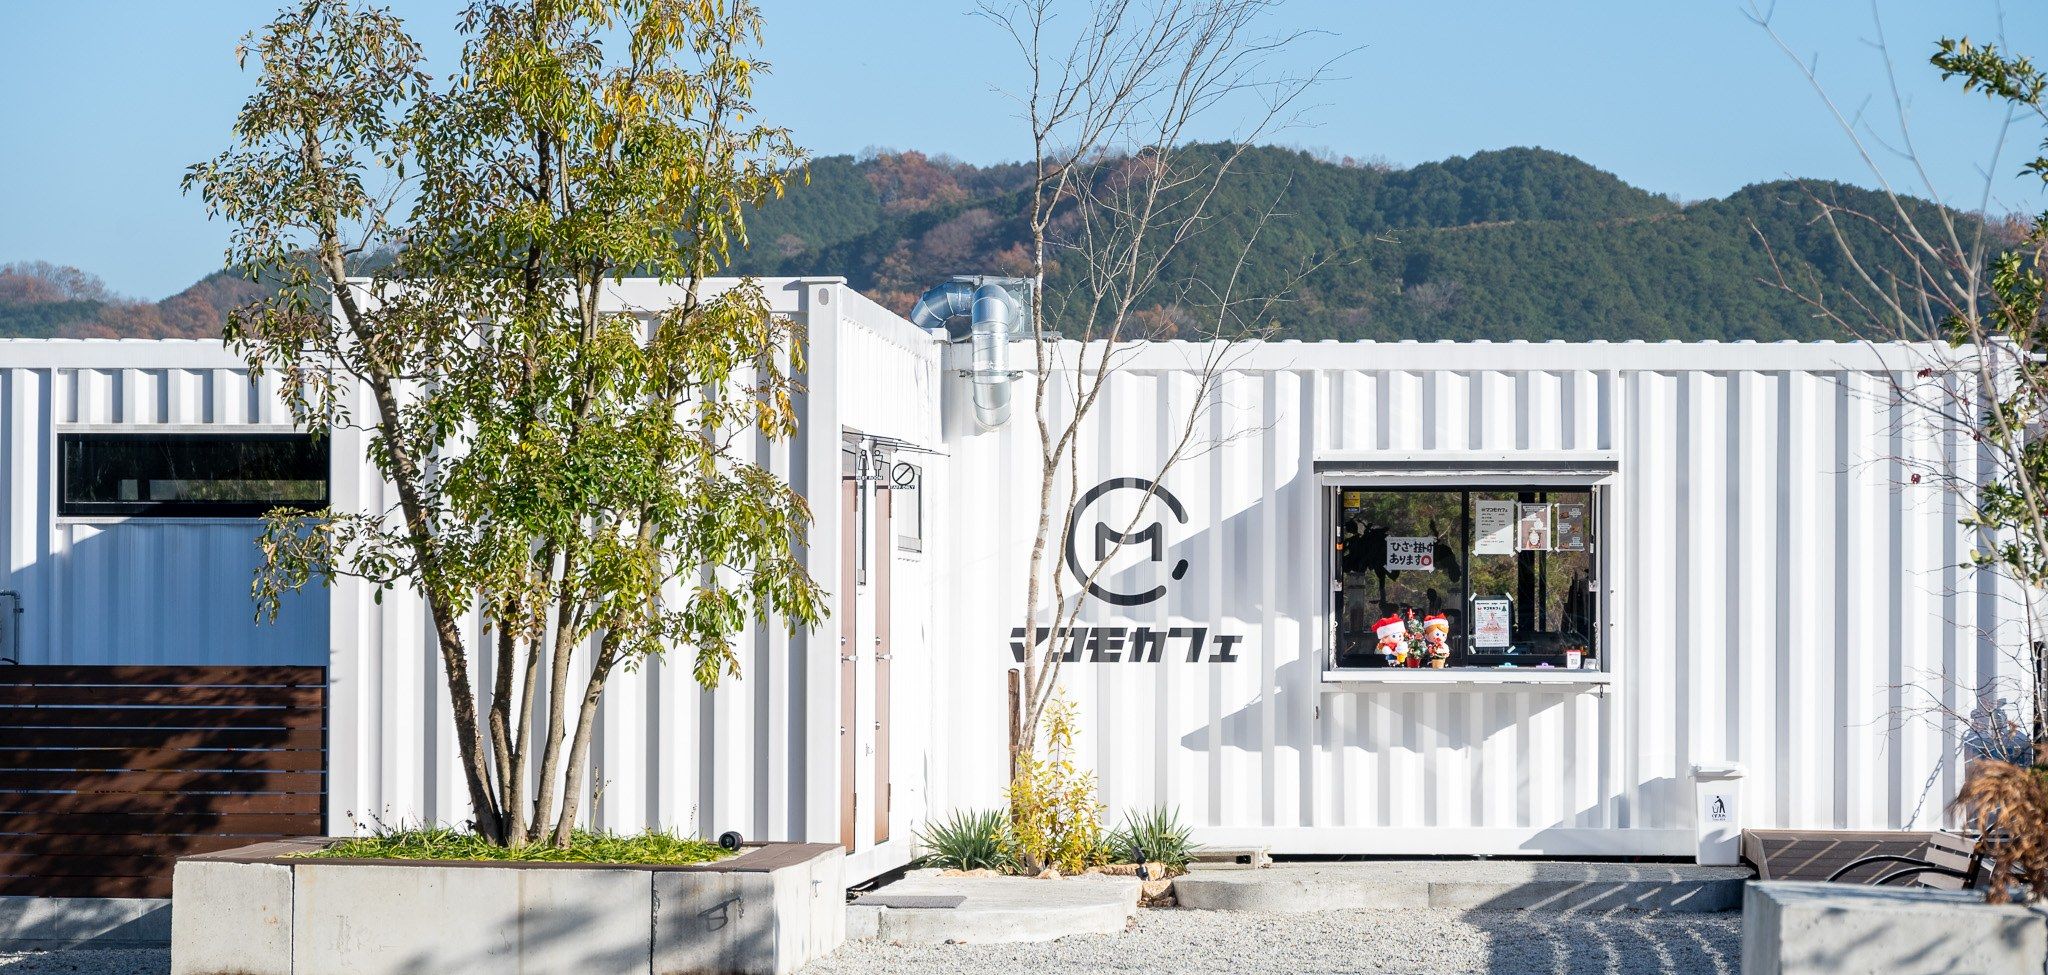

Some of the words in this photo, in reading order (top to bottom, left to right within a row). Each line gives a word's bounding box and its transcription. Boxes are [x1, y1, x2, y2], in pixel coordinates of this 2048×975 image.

[1390, 553, 1421, 565] あります
[1009, 626, 1244, 663] マコモカフェ
